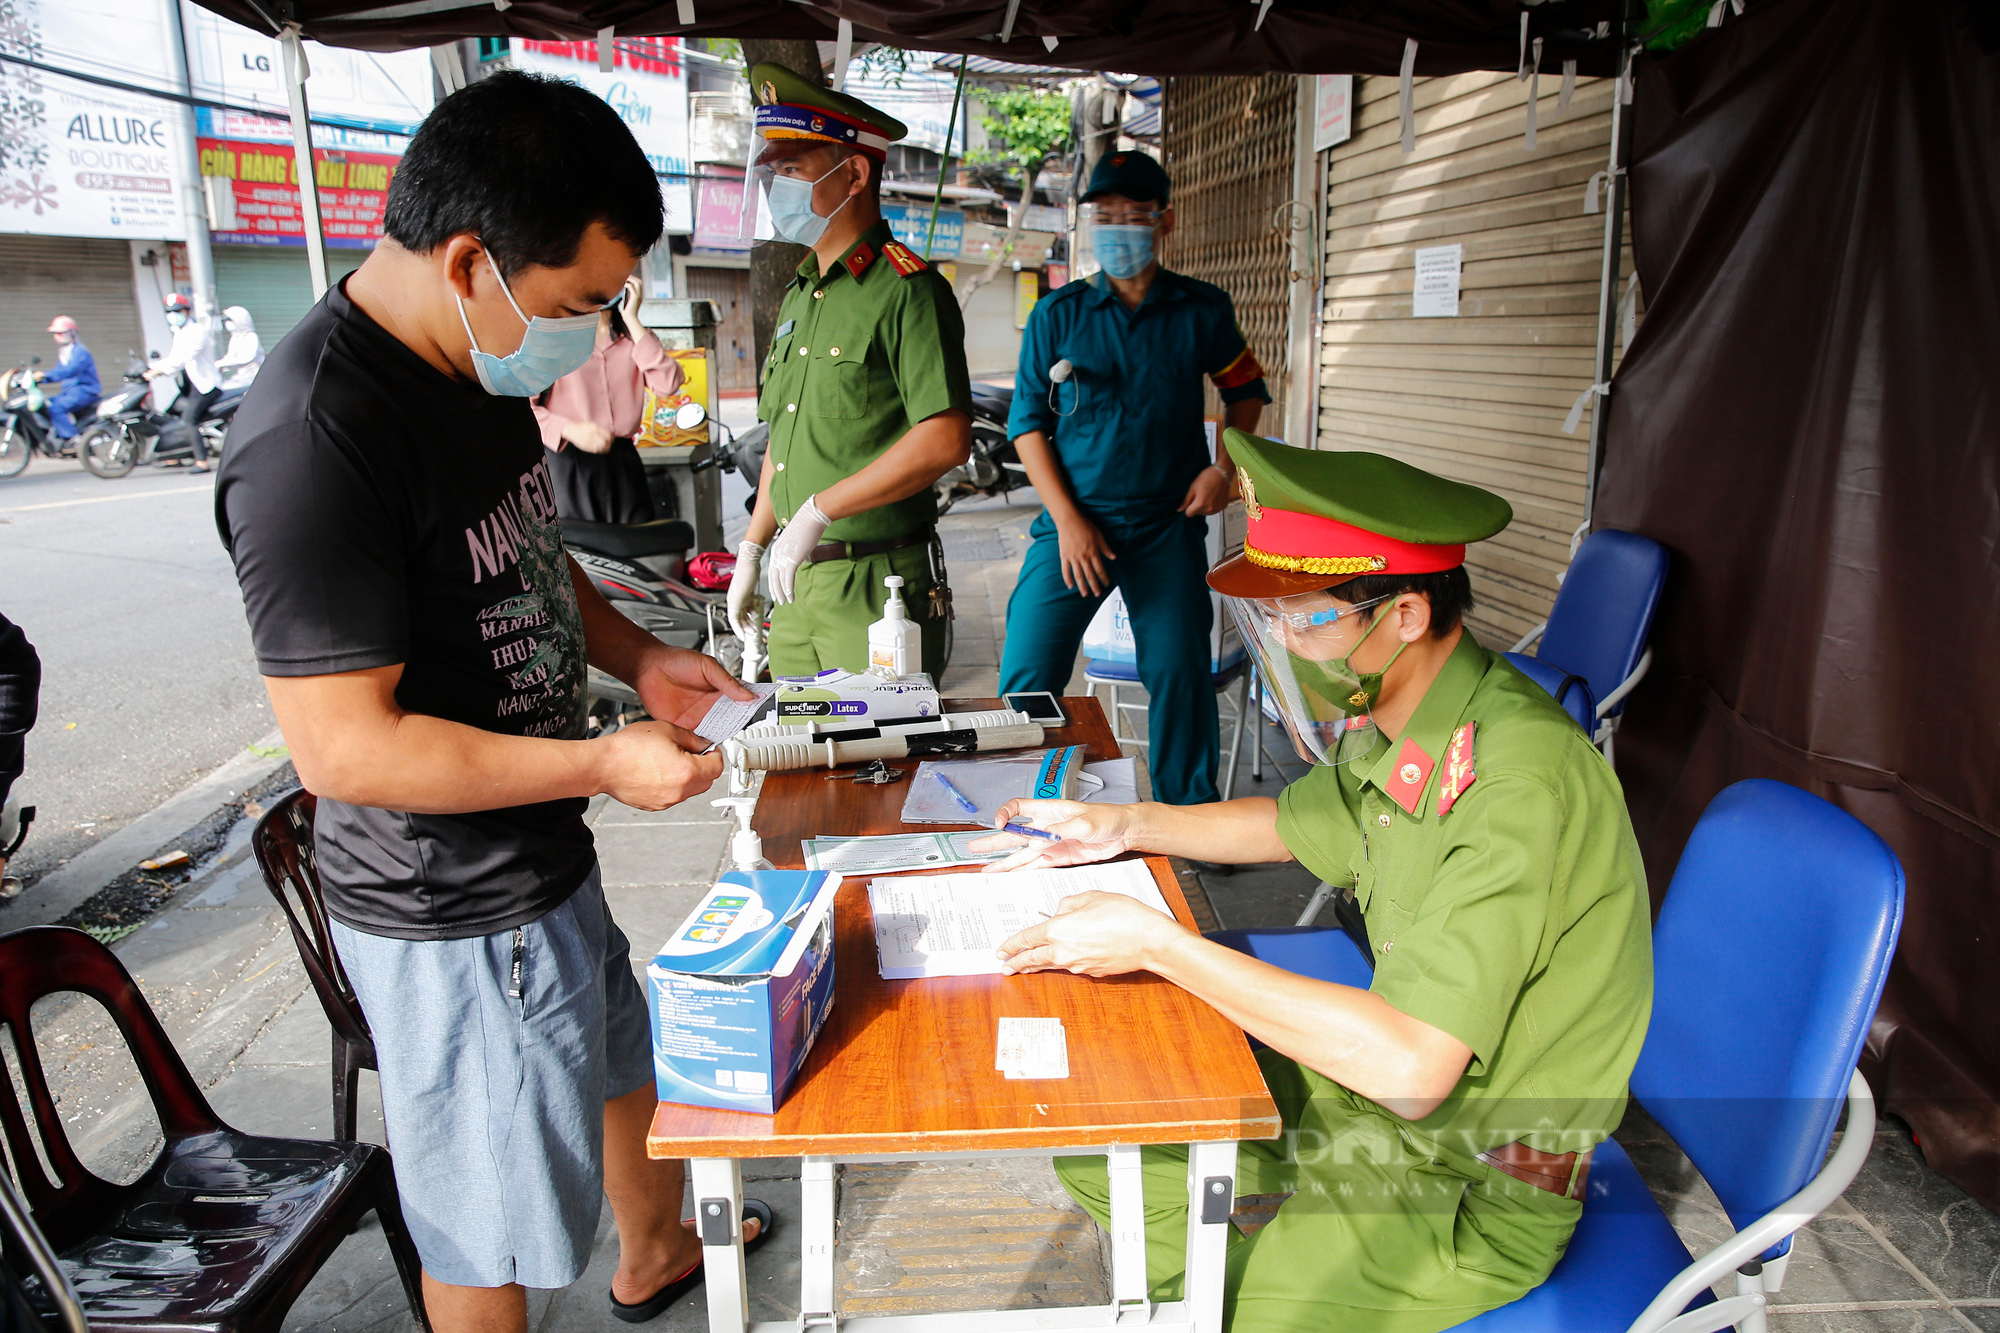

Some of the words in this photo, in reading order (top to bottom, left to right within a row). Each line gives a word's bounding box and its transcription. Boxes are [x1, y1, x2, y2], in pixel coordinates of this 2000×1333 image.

[242, 54, 270, 71] LG
[67, 114, 165, 148] ALLURE
[69, 149, 170, 173] BOUTIQUE
[240, 150, 287, 184] HÀNG
[348, 162, 388, 191] LONG
[836, 702, 859, 714] Latex
[801, 968, 818, 1002] FACE
